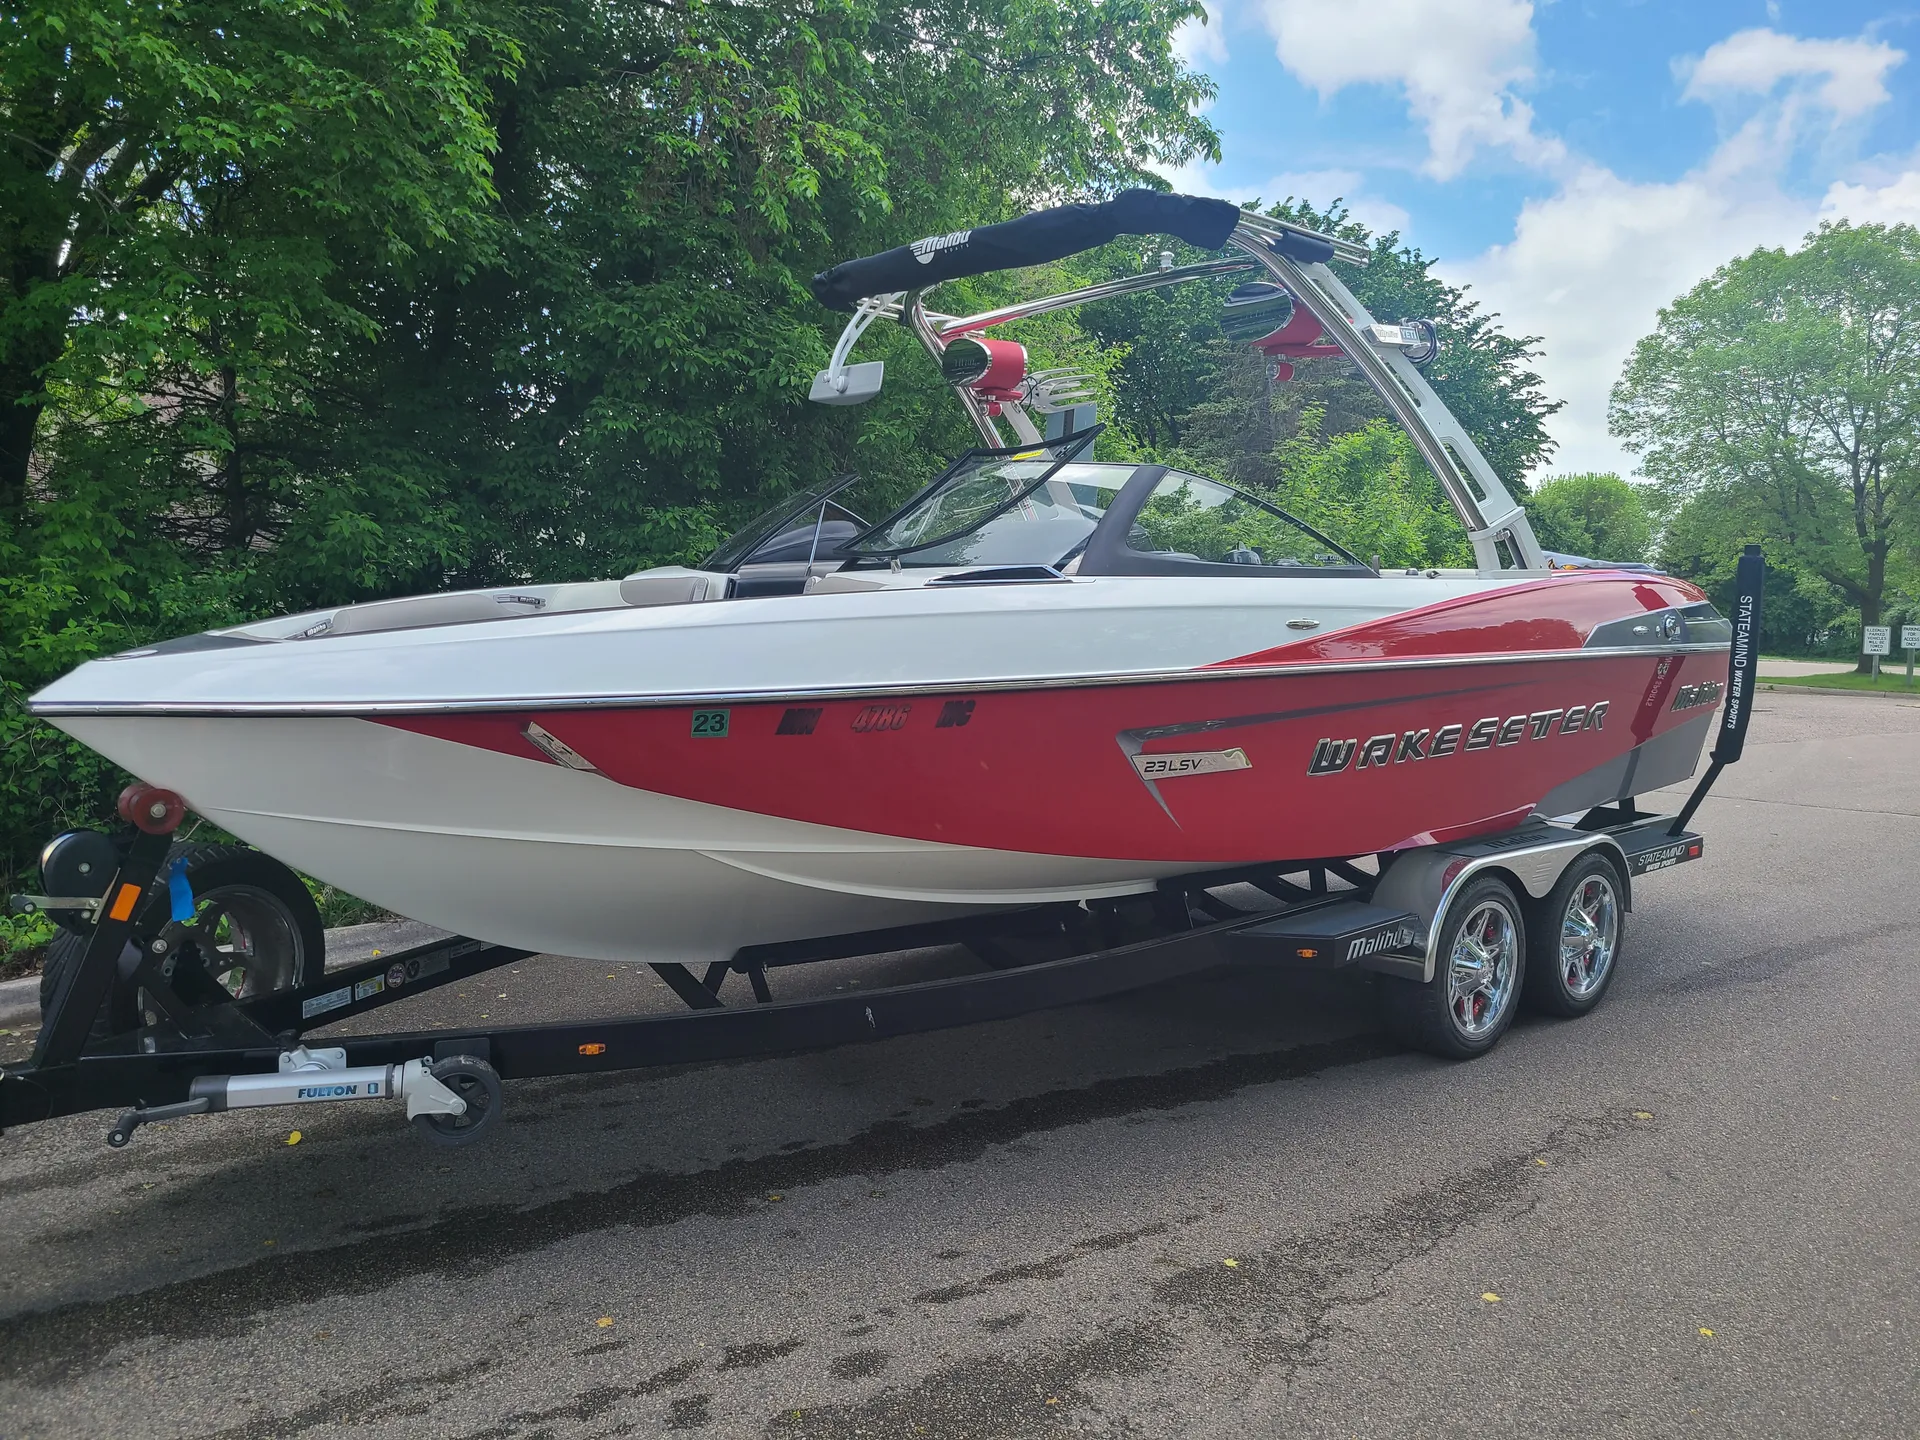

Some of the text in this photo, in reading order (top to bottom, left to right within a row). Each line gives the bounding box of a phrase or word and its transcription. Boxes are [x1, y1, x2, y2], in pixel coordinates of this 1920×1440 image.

[1727, 595, 1753, 730] STATEAMIND WATER SPORTS
[693, 713, 726, 733] 23
[851, 704, 912, 733] 4786
[1306, 700, 1610, 777] WAKESETER
[1638, 845, 1685, 866] STATEAMIND
[1645, 857, 1677, 872] WATER SPORTS
[1346, 929, 1403, 961] Malibu
[298, 1085, 358, 1098] FULTON
